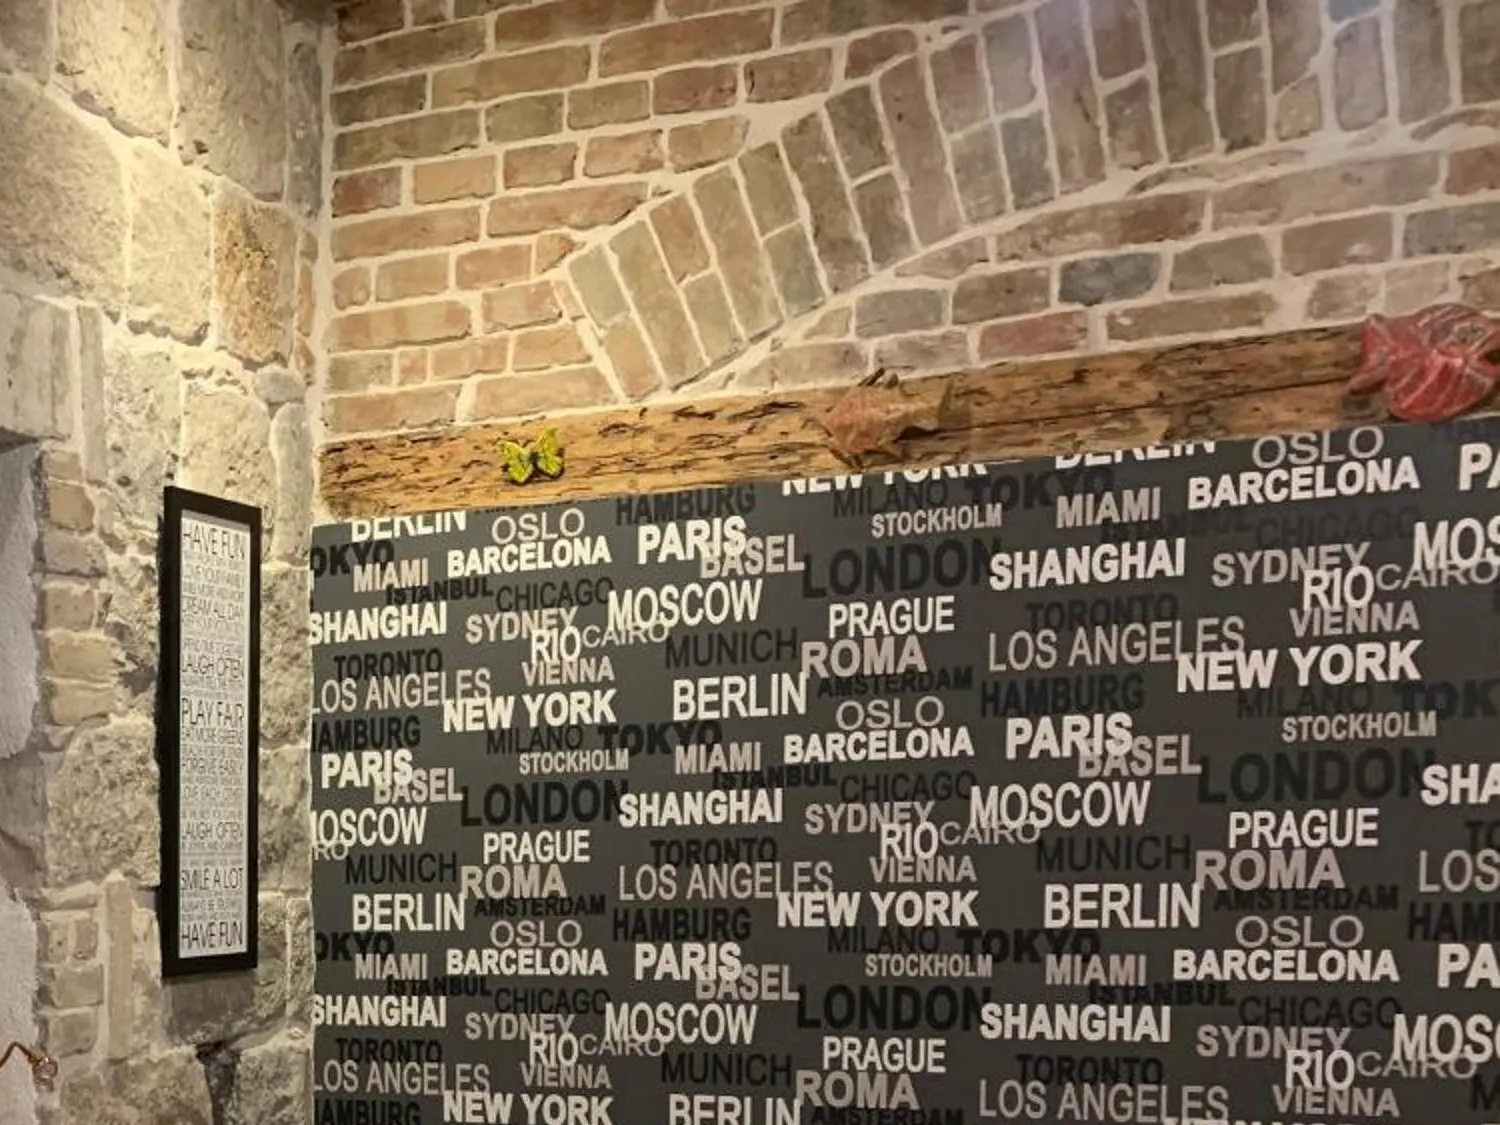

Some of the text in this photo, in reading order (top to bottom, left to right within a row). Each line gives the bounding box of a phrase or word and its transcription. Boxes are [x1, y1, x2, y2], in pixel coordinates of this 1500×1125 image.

[1252, 426, 1385, 469] OSLO
[1188, 456, 1420, 511] BARCELONA
[492, 507, 584, 545] OSLO
[871, 503, 1002, 539] STOCKHOLM
[1057, 488, 1161, 528] MIAMI
[447, 535, 611, 579] BARCELONA
[638, 515, 746, 564] PARIS
[700, 534, 805, 579] BASEL
[353, 557, 429, 593] MIAMI
[989, 537, 1186, 591] SHANGHAI
[1212, 543, 1371, 587] SYDNEY
[498, 577, 614, 613] CHICAGO
[608, 579, 762, 633] MOSCOW
[1303, 567, 1375, 613] RIO
[311, 602, 447, 645] SHANGHAI
[466, 606, 578, 644] SYDNEY
[581, 616, 669, 649] CAIRO
[829, 596, 955, 638] PRAGUE
[1290, 601, 1419, 637] VIENNA
[531, 627, 581, 665] RIO
[666, 628, 798, 670] MUNICH
[801, 635, 928, 678] ROMA
[989, 616, 1244, 673] LOS ANGELES
[334, 649, 443, 682] TORONTO
[523, 655, 615, 687] VIENNA
[1177, 639, 1422, 693] NEW YORK
[182, 697, 244, 726] PLAY FAIR
[443, 689, 617, 734] NEW YORK
[672, 672, 806, 721] BERLIN
[836, 697, 945, 732] OSLO
[783, 727, 974, 764] BARCELONA
[1006, 712, 1134, 760] PARIS
[1283, 711, 1437, 743] STOCKHOLM
[321, 748, 414, 789] PARIS
[519, 748, 629, 774] STOCKHOLM
[675, 742, 761, 774] MIAMI
[1079, 735, 1201, 778] BASEL
[619, 787, 784, 828] SHANGHAI
[969, 780, 1150, 829] MOSCOW
[483, 829, 591, 866] PRAGUE
[880, 820, 939, 861] RIO
[1230, 807, 1379, 850] PRAGUE
[224, 868, 243, 889] LOT
[345, 852, 459, 886] MUNICH
[460, 864, 567, 899] ROMA
[620, 860, 834, 901] LOS ANGELES
[1197, 850, 1344, 890] ROMA
[352, 893, 466, 932] BERLIN
[777, 890, 978, 927] NEW YORK
[1044, 883, 1200, 929] BERLIN
[490, 920, 582, 948] OSLO
[1235, 916, 1364, 949] OSLO
[356, 954, 428, 980] MIAMI
[446, 949, 608, 976] BARCELONA
[635, 942, 743, 982] PARIS
[1046, 954, 1146, 987] MIAMI
[1173, 949, 1399, 982] BARCELONA
[696, 963, 799, 1001] BASEL
[311, 995, 447, 1027] SHANGHAI
[465, 1013, 575, 1041] SYDNEY
[604, 1002, 758, 1045] MOSCOW
[980, 1004, 1171, 1042] SHANGHAI
[529, 1033, 578, 1066] RIO
[1196, 1025, 1351, 1059] SYDNEY
[520, 1063, 611, 1089] VIENNA
[1285, 1050, 1355, 1090] RIO
[444, 1092, 513, 1124] NEW
[979, 1079, 1228, 1122] LOS ANGELES
[1272, 1084, 1398, 1116] VIENNA
